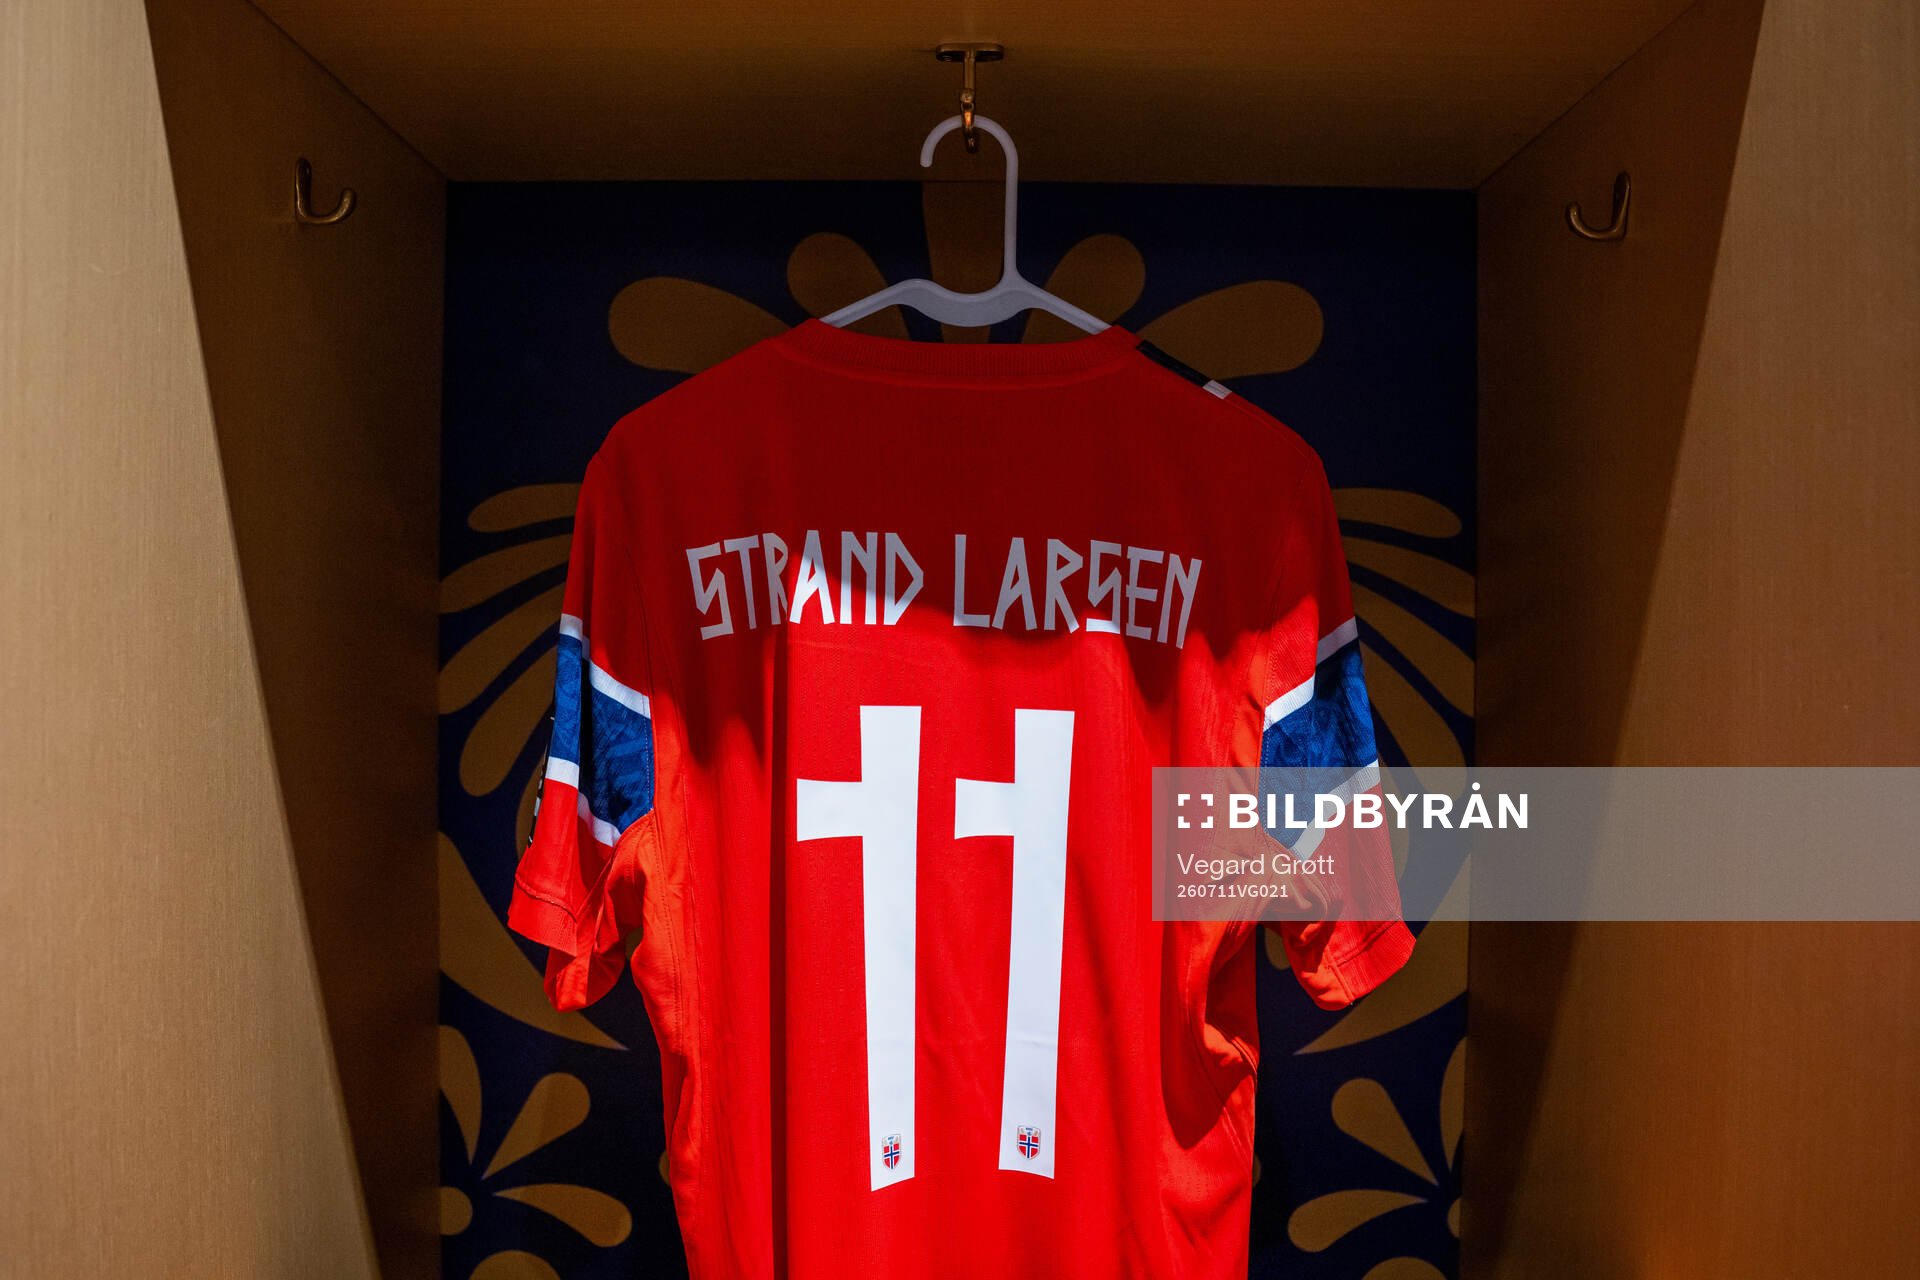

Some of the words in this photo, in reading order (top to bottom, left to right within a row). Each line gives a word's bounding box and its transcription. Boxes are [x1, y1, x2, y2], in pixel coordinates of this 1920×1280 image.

[686, 530, 924, 640] STRAND
[953, 534, 1202, 649] LARSEN
[797, 705, 1075, 1191] 11
